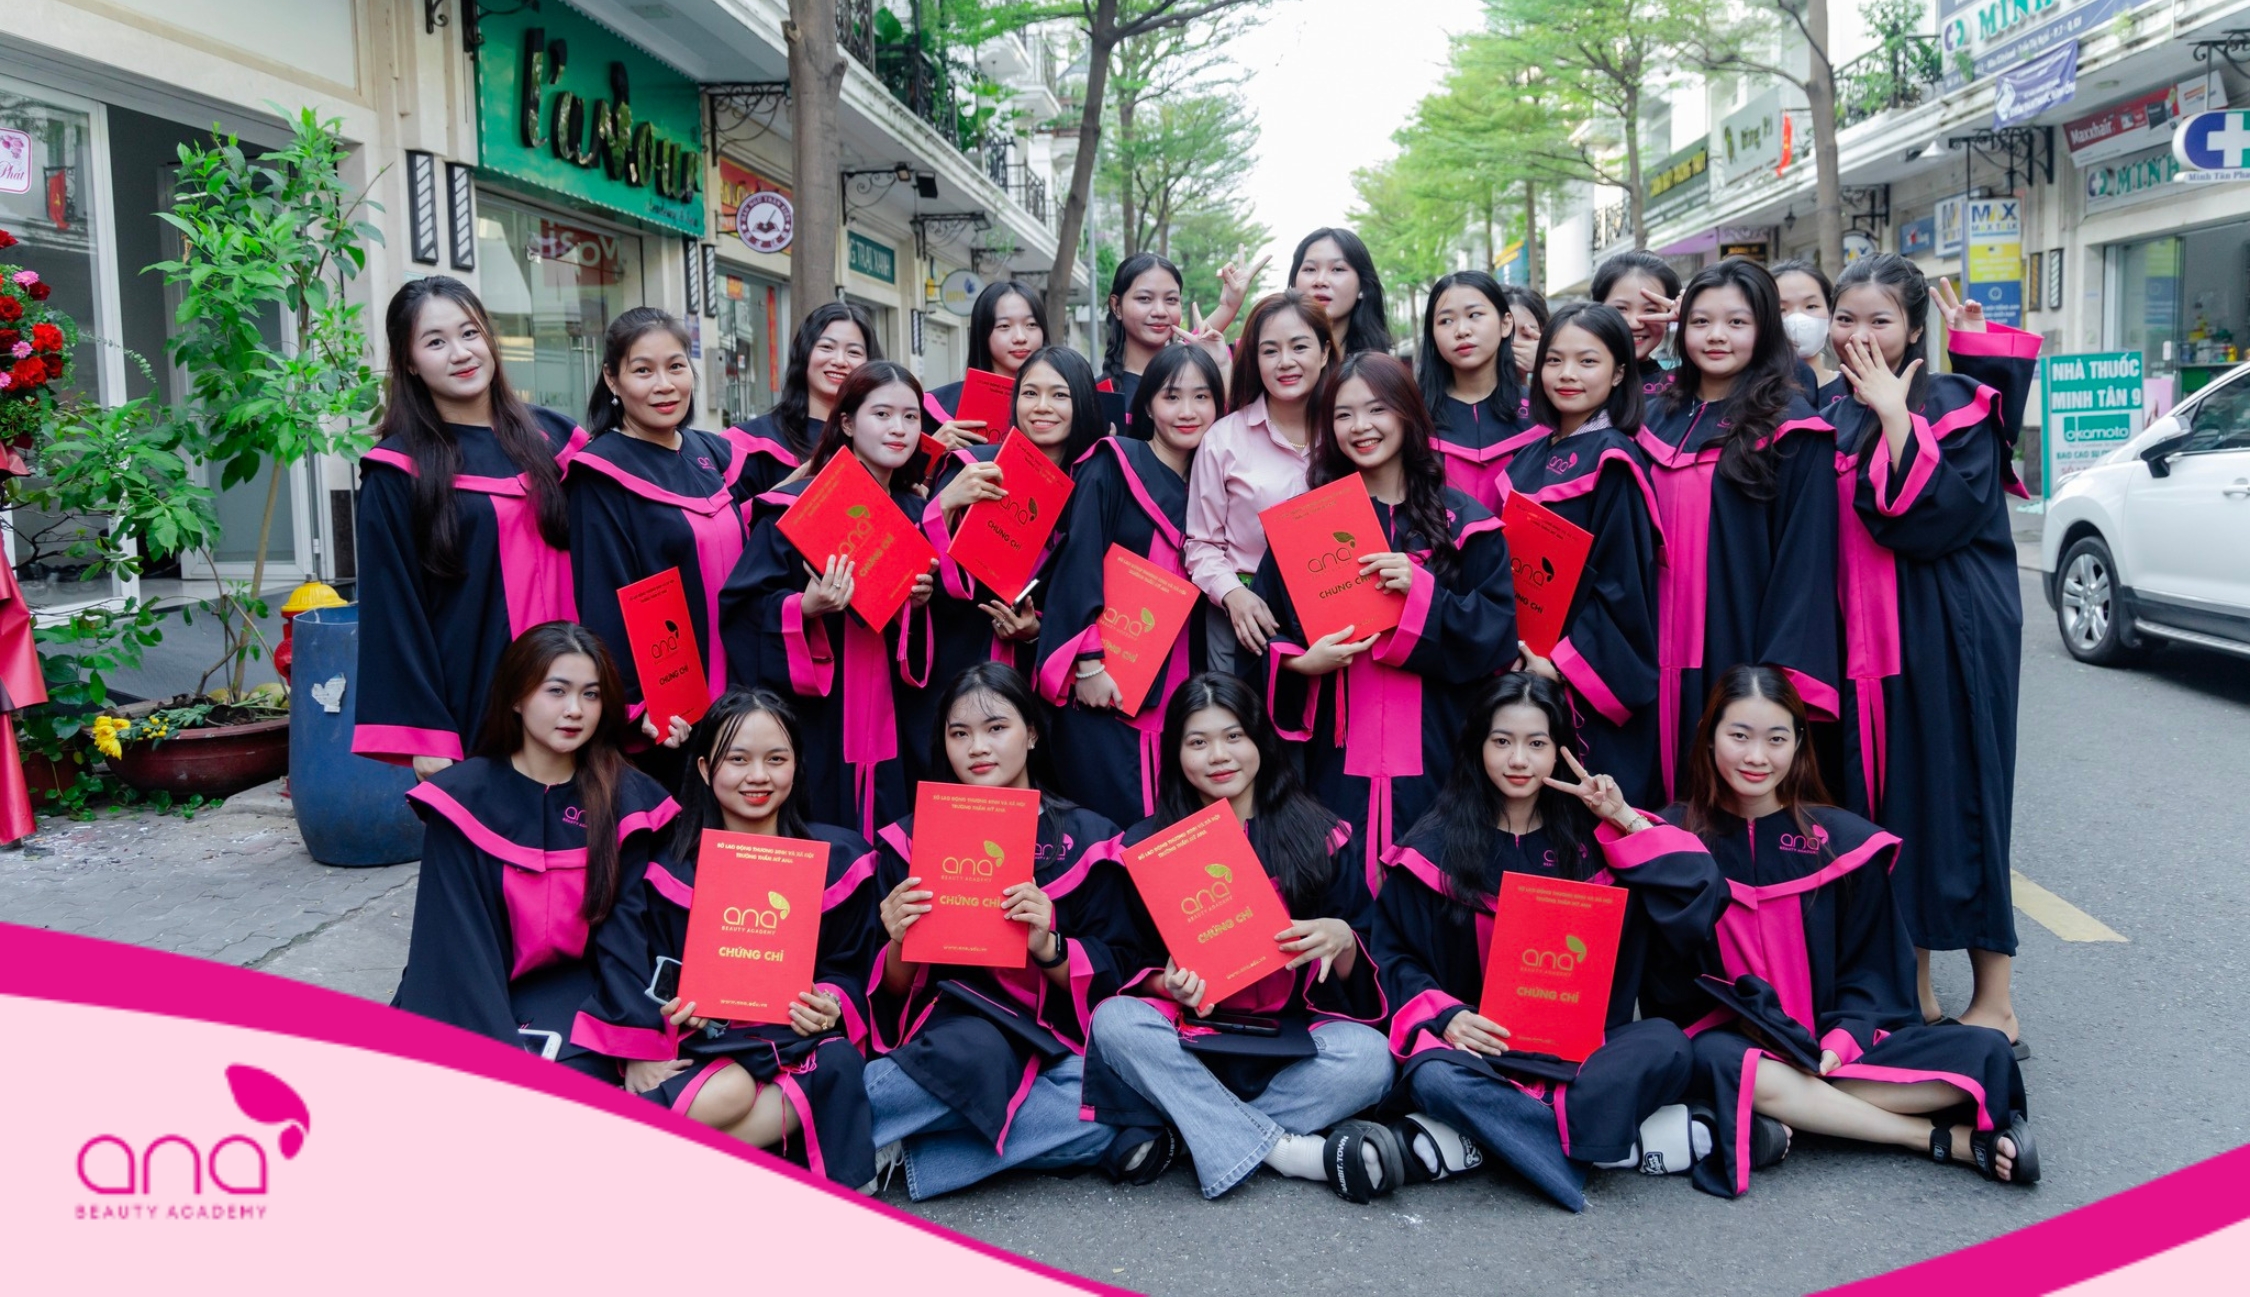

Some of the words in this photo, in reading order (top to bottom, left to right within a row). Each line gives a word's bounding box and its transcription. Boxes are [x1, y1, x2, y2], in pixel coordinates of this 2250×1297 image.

[1972, 203, 2017, 222] MAX
[2052, 358, 2085, 381] NHÀ
[2089, 352, 2140, 379] THUỐC
[2051, 390, 2093, 410] MINH
[2097, 385, 2128, 408] TÂN
[2131, 388, 2142, 406] 9
[2065, 418, 2129, 441] okamoto
[1308, 547, 1352, 573] ana
[1511, 557, 1545, 587] ana
[1103, 607, 1143, 637] ana
[1781, 833, 1819, 850] ana
[942, 856, 993, 876] ana
[1181, 881, 1230, 915] ana
[723, 906, 777, 929] ana
[719, 946, 761, 960] CHỨNG
[764, 949, 785, 962] CHỈ
[1522, 948, 1574, 971] ana
